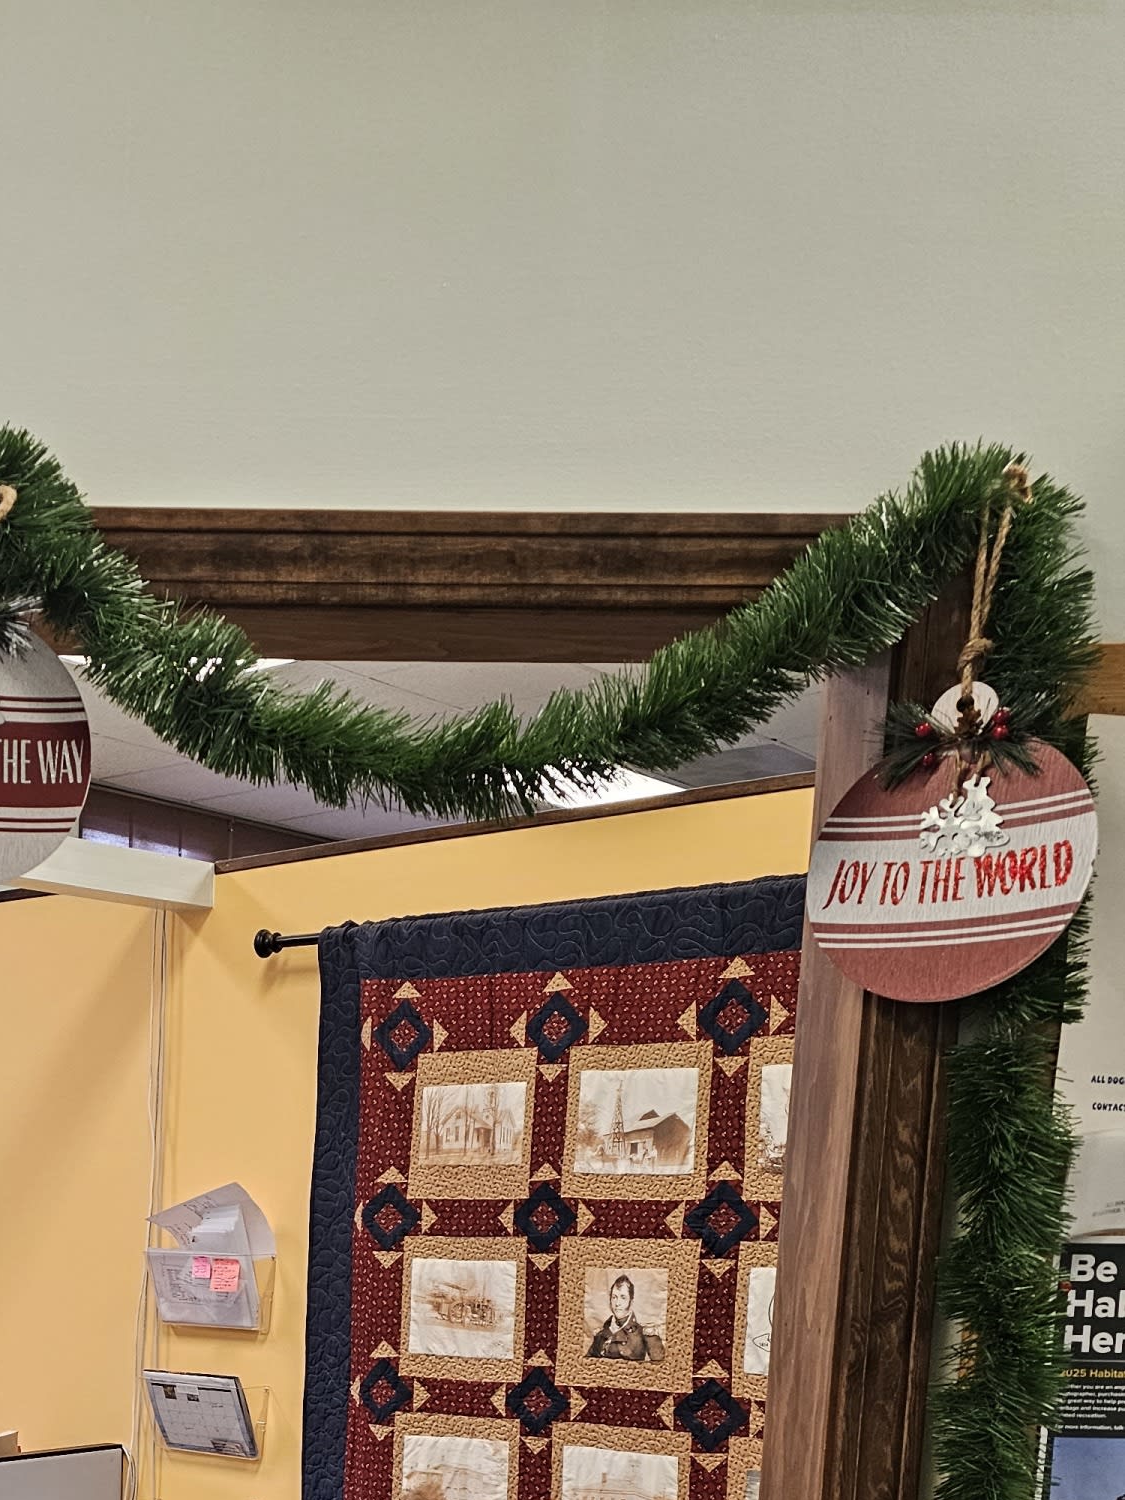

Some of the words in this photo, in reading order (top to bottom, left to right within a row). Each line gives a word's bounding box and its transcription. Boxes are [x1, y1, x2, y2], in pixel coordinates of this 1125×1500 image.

[37, 739, 84, 784] WAY
[821, 859, 877, 910] JOY
[879, 861, 910, 906] TO
[918, 856, 965, 905] THE
[974, 840, 1074, 898] WORLD
[1091, 1075, 1106, 1084] ALL
[1070, 1254, 1118, 1282] Be
